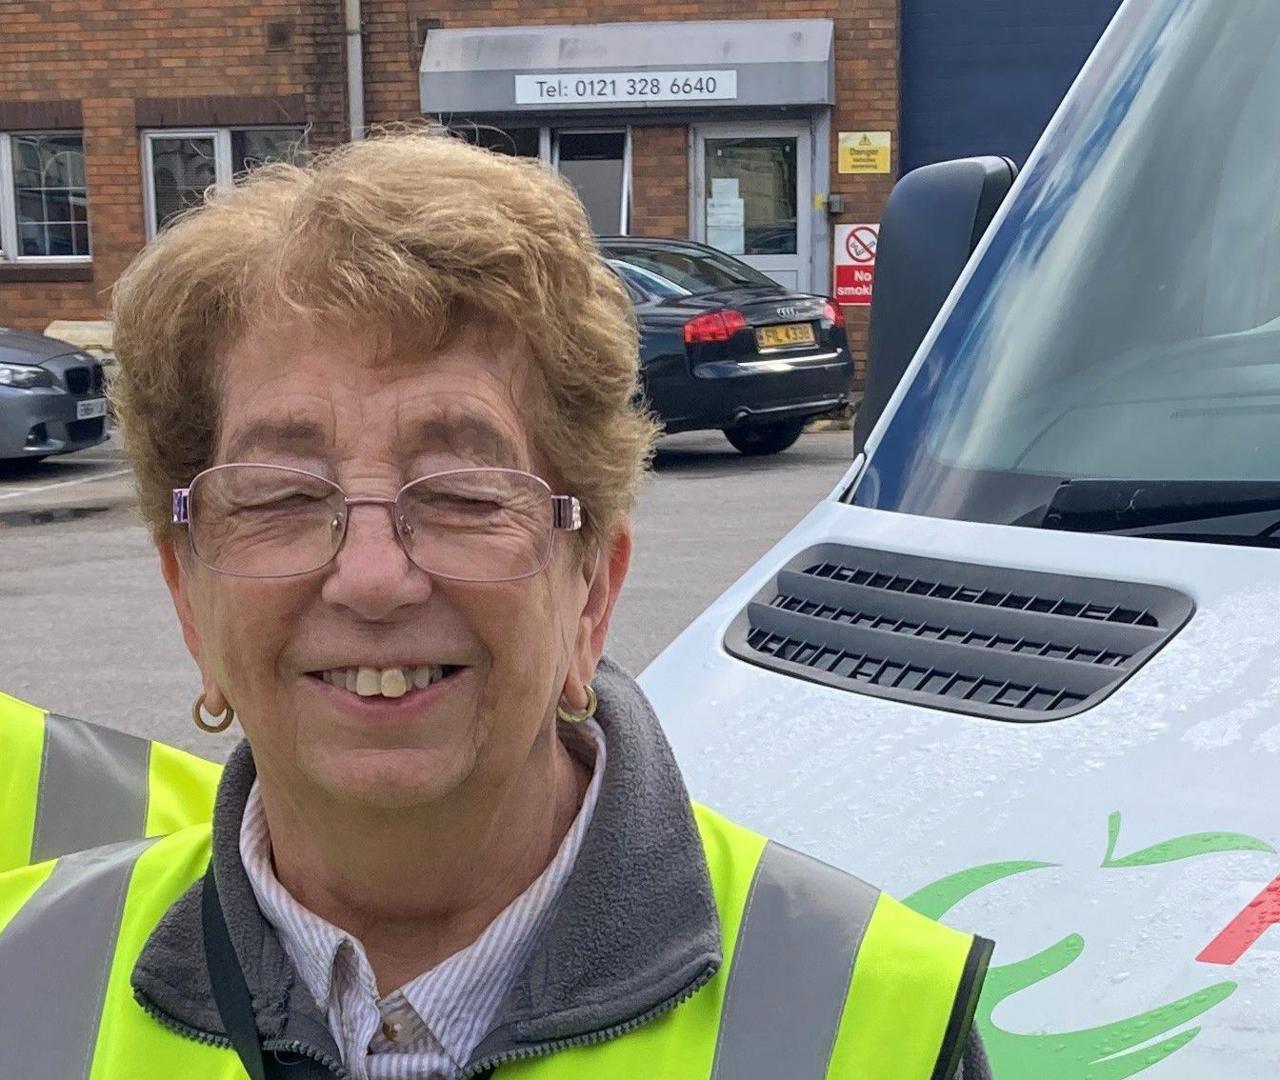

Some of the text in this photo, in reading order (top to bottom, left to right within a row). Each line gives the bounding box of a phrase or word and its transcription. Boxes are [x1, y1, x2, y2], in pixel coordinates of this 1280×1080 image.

[536, 76, 717, 98] Tel: 0121 328 6640
[854, 270, 872, 282] No
